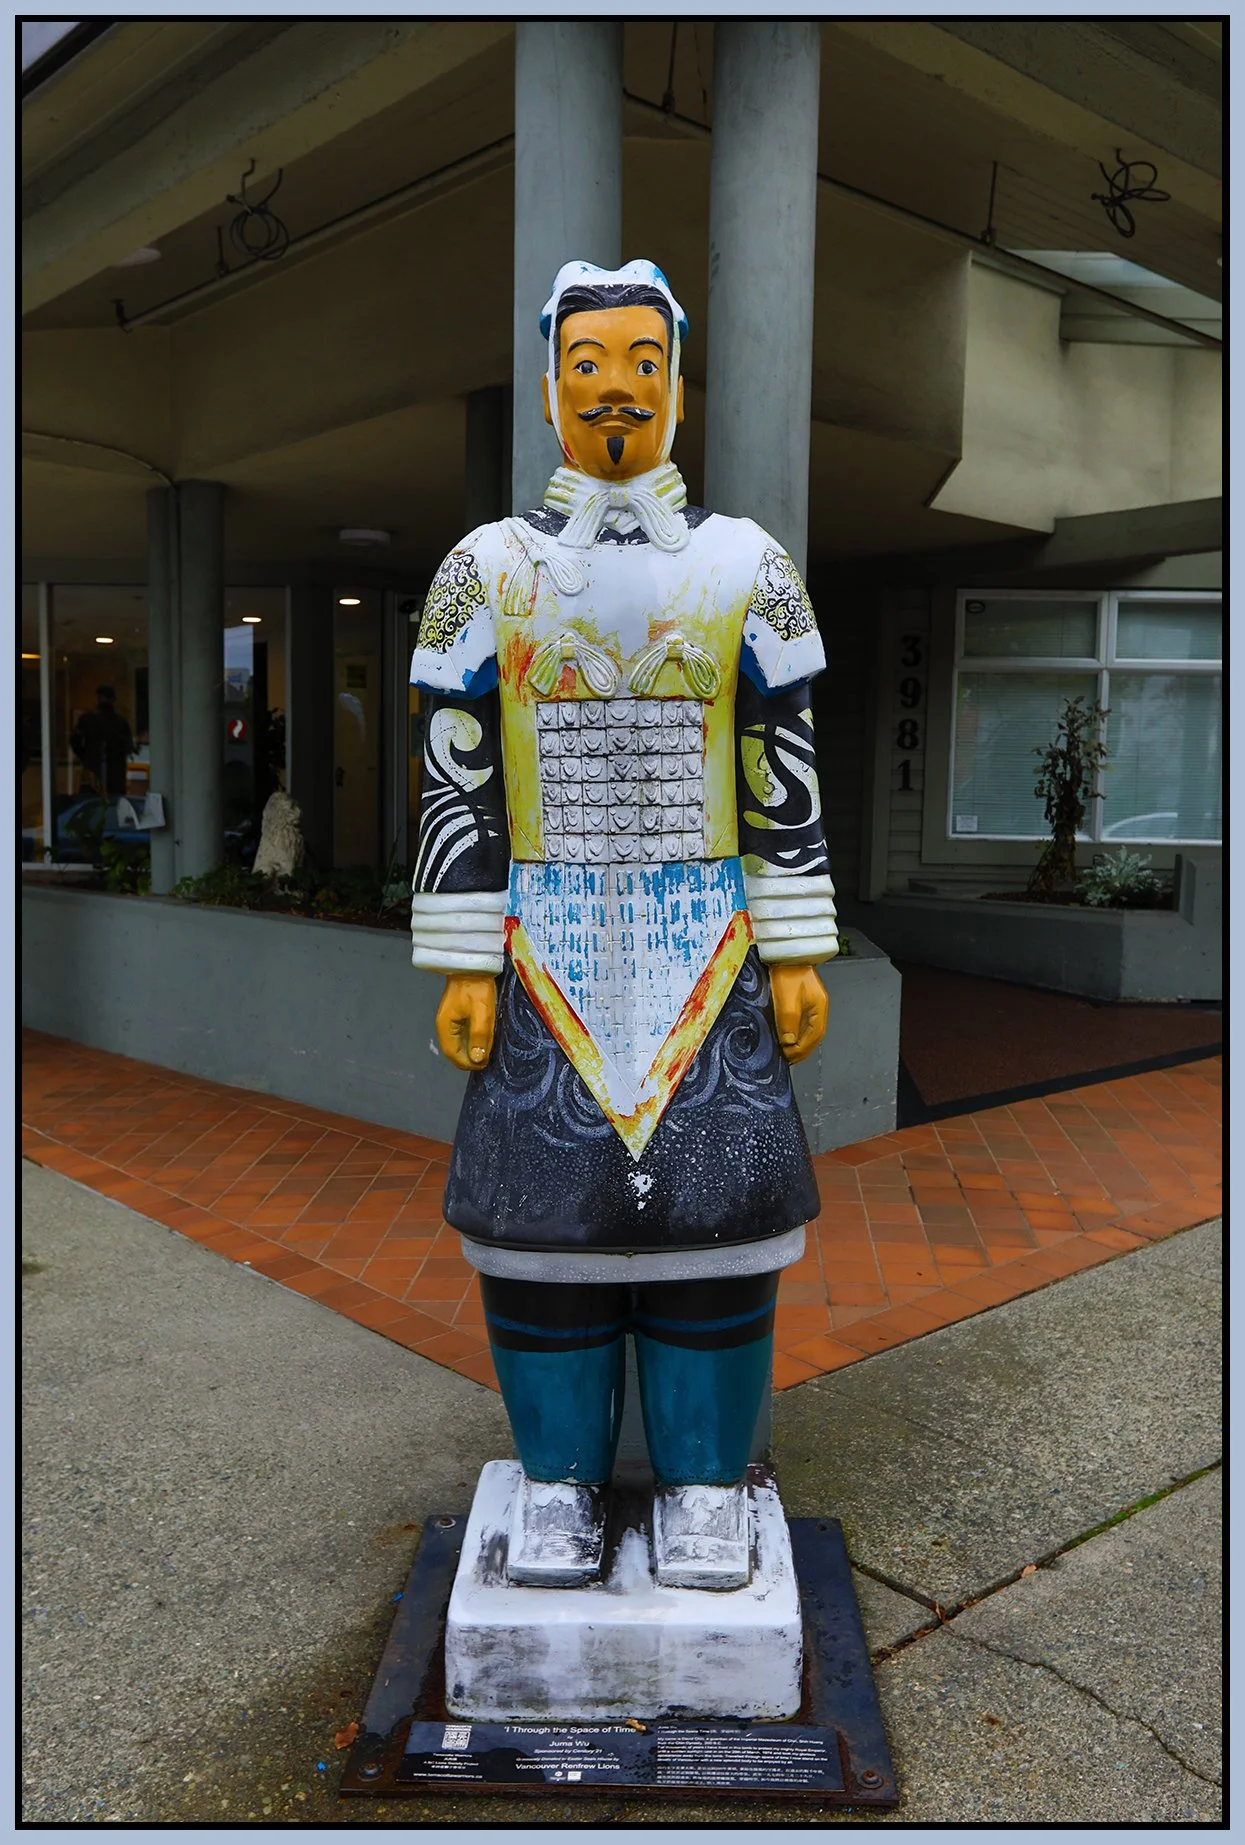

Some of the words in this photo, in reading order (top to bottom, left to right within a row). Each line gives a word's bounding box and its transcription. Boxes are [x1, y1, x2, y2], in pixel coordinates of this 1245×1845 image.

[896, 635, 922, 791] 3981
[512, 1726, 551, 1735] Through
[570, 1726, 600, 1735] Space
